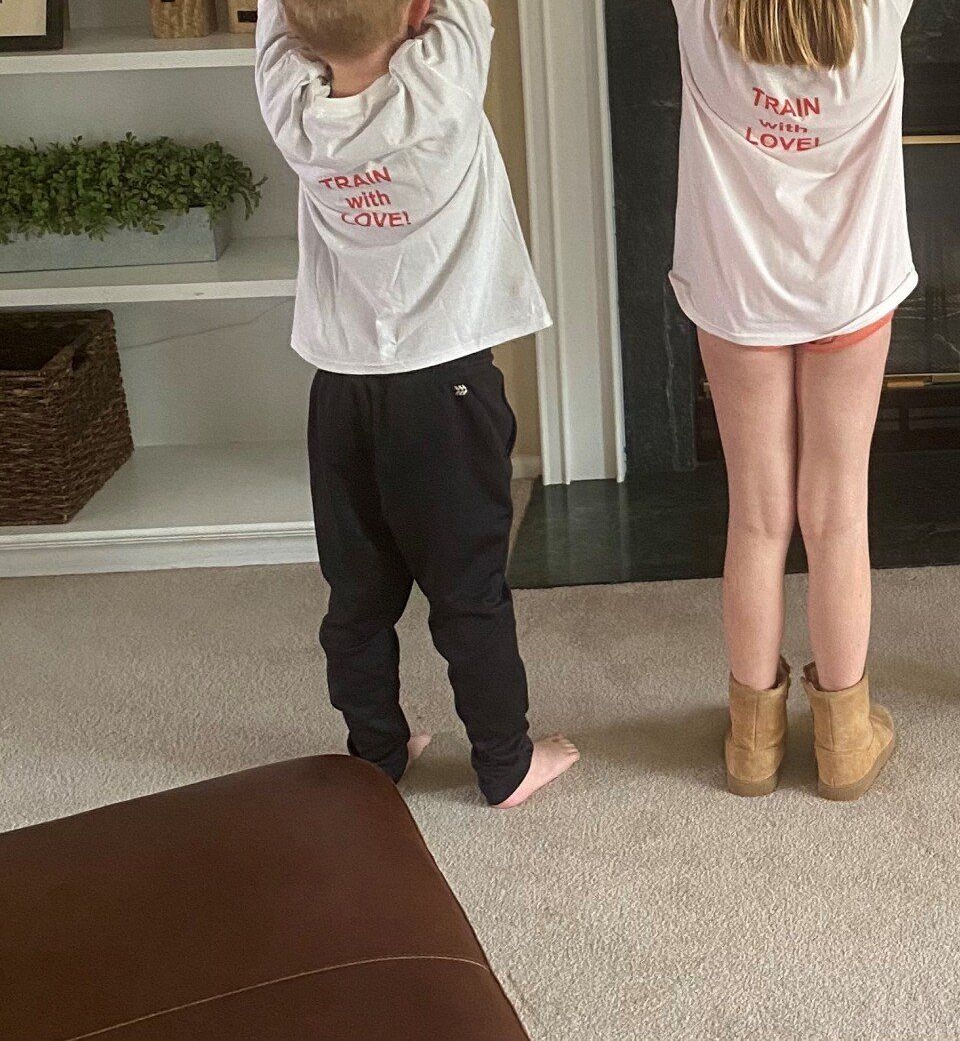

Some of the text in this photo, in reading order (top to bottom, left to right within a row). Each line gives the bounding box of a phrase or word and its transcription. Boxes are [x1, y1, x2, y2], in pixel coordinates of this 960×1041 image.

[752, 86, 820, 117] TRAIN
[759, 119, 808, 133] with
[745, 126, 820, 152] LOVE!
[318, 166, 392, 190] TRAIN
[345, 189, 391, 209] with
[341, 210, 412, 228] LOVE!
